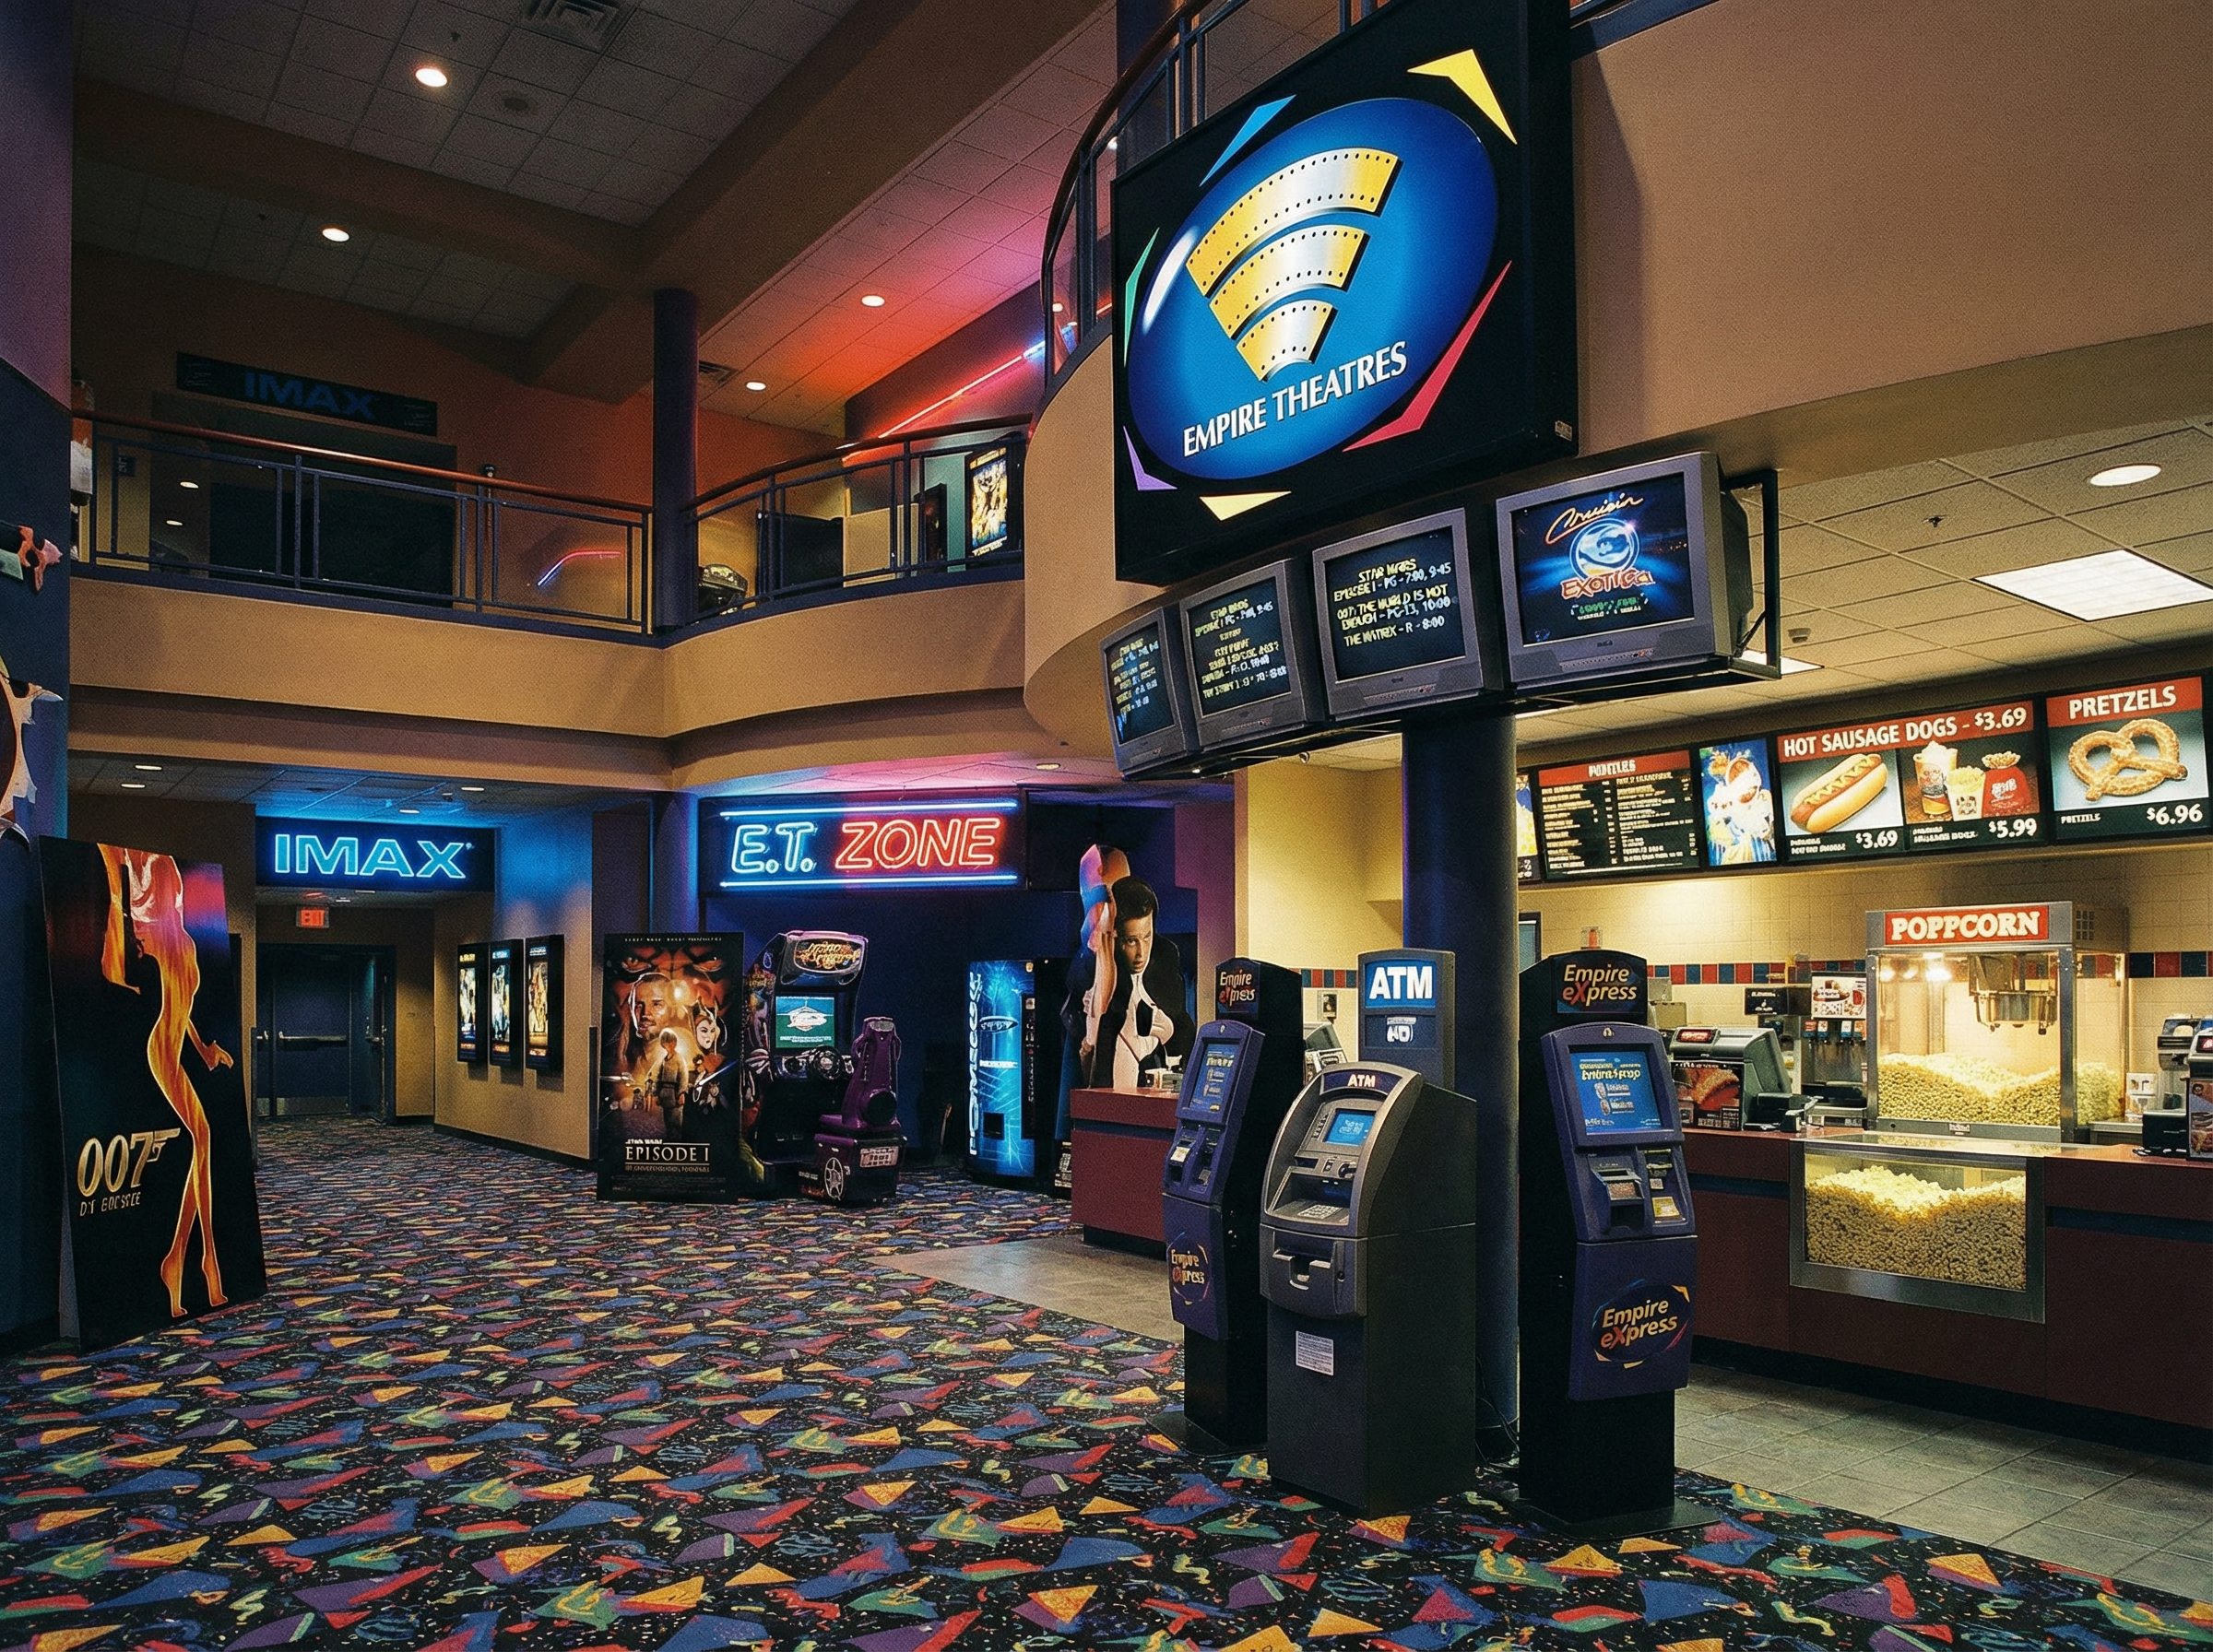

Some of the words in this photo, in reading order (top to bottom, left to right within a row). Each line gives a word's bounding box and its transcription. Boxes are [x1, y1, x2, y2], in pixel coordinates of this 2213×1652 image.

[244, 372, 375, 419] IMAX
[1183, 396, 1268, 457] EMPIRE
[1272, 340, 1409, 422] THEATRES
[1413, 589, 1426, 602] IS
[1405, 621, 1414, 633] R
[2068, 685, 2177, 720] PRETZELS
[1783, 735, 1817, 757] HOT
[1821, 725, 1900, 753] SAUSAGE
[1905, 716, 1958, 742] DOGS
[1973, 706, 2028, 732] $3.69
[1988, 818, 2038, 839] $5.99
[2146, 803, 2204, 826] $6.96
[731, 821, 816, 873] E.T.
[834, 818, 1000, 869] ZONE
[1855, 830, 1899, 849] $3.69
[274, 833, 467, 879] IMAX
[1891, 910, 2041, 942] POPPCORN
[1368, 965, 1434, 1000] ATM
[1563, 963, 1630, 986] Empire
[1347, 1073, 1377, 1088] ATM
[77, 1130, 155, 1198] 007
[625, 1146, 697, 1162] EPISODE
[704, 1147, 709, 1162] I
[1602, 1299, 1670, 1328] Empire
